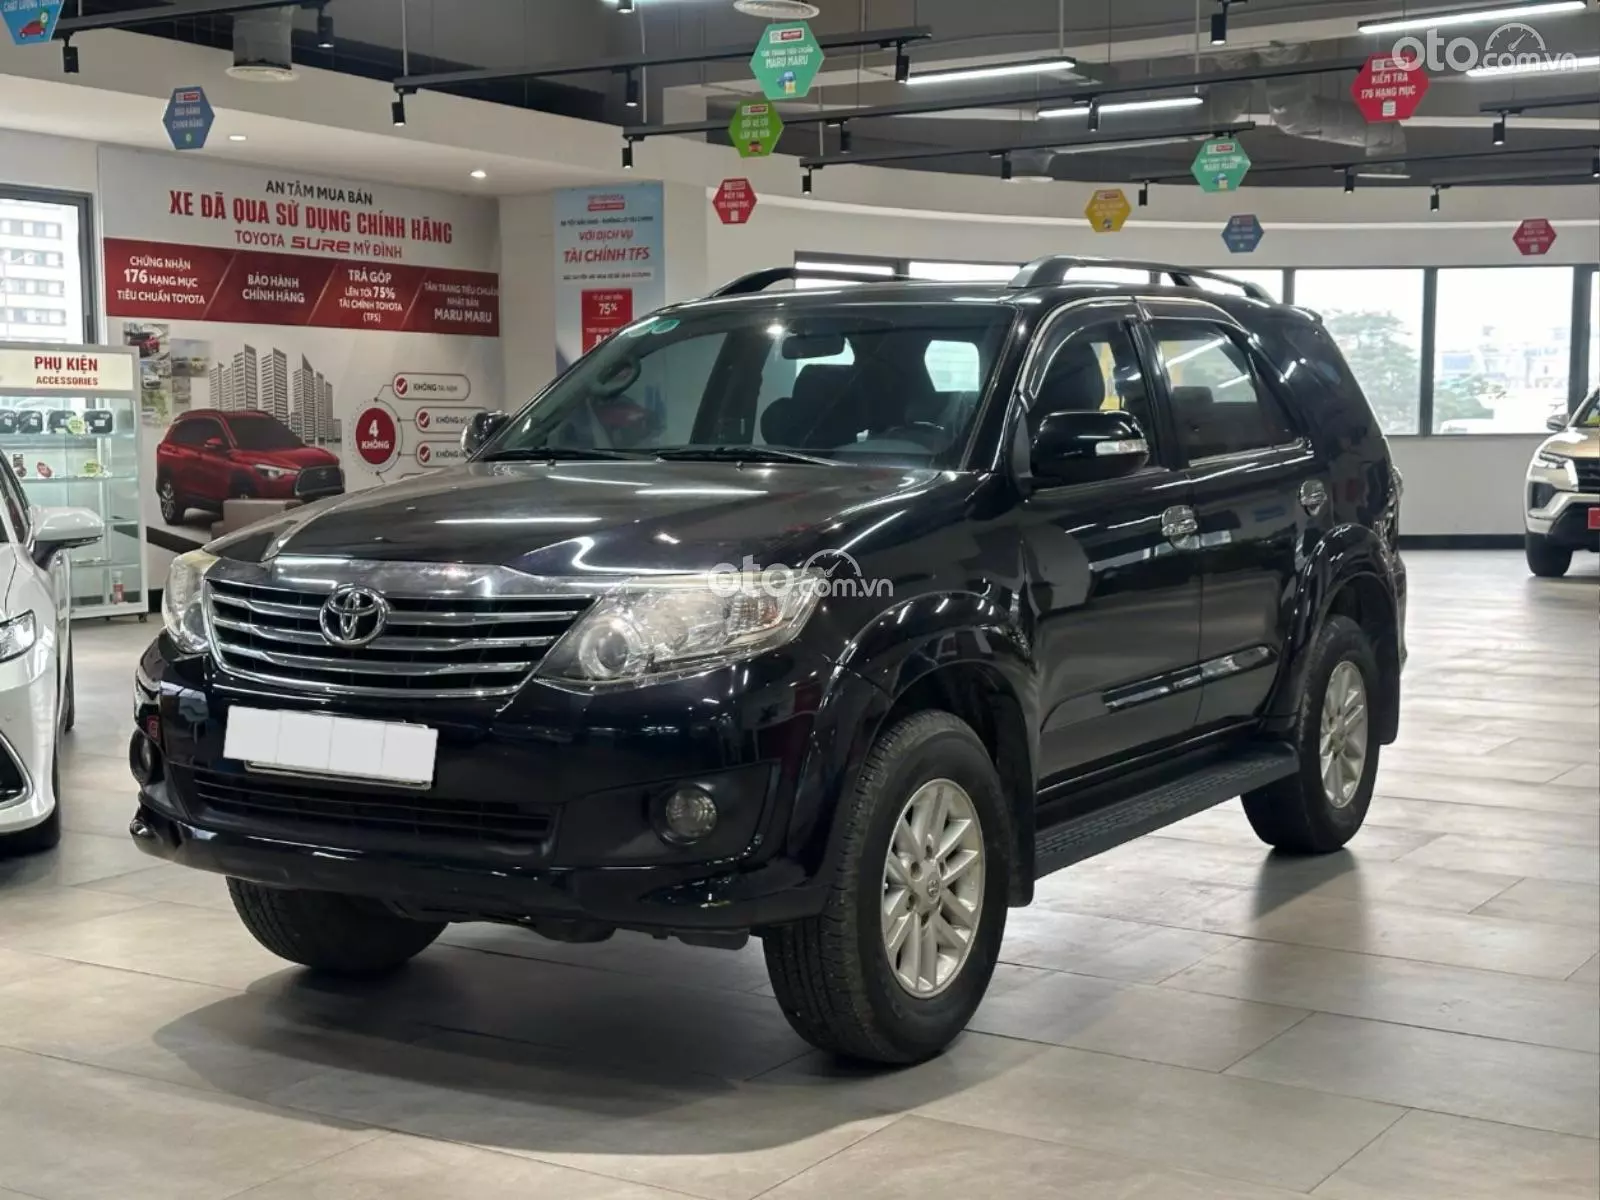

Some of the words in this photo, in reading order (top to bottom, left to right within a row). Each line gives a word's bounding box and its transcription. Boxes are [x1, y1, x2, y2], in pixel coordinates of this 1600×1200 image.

[1392, 72, 1408, 83] TRA
[265, 179, 285, 195] AN
[287, 180, 315, 198] TÂM
[316, 185, 345, 202] MUA
[347, 188, 373, 206] BÁN
[169, 190, 194, 216] XE
[200, 191, 227, 220] ĐÃ
[232, 197, 270, 224] QUA
[275, 200, 300, 227] SỬ
[305, 205, 351, 234] DỤNG
[357, 209, 406, 240] CHÍNH
[411, 216, 453, 244] HÃNG
[234, 229, 285, 247] TOYOTA
[353, 240, 371, 256] MỸ
[373, 241, 402, 258] ĐÌNH
[564, 246, 583, 263] TÀI
[584, 244, 626, 262] CHÍNH
[628, 247, 651, 261] TFS
[129, 254, 163, 268] CHỨNG
[164, 258, 191, 271] NHẬN
[123, 268, 149, 285] 176
[149, 274, 177, 288] HẠNG
[177, 276, 199, 289] MỤC
[247, 272, 270, 286] BẢO
[270, 274, 300, 289] HÀNH
[348, 266, 369, 282] TRẢ
[369, 268, 393, 284] GÓP
[116, 288, 137, 301] TIÊU
[138, 289, 171, 303] CHUẨN
[171, 292, 206, 305] TOYOTA
[241, 287, 276, 301] CHÍNH
[372, 286, 397, 300] 75%
[375, 301, 403, 312] TOYOTA
[598, 302, 618, 316] 75%
[362, 311, 381, 323] (TFS)
[434, 307, 463, 321] MARU
[463, 309, 493, 323] MARU
[34, 356, 62, 373] PHỤ
[66, 354, 98, 374] KIỆN
[36, 376, 99, 386] ACCESSORIES
[413, 382, 437, 392] KHÔNG
[435, 415, 460, 425] KHÔNG
[368, 419, 379, 438] 4
[361, 439, 390, 450] KHÔNG
